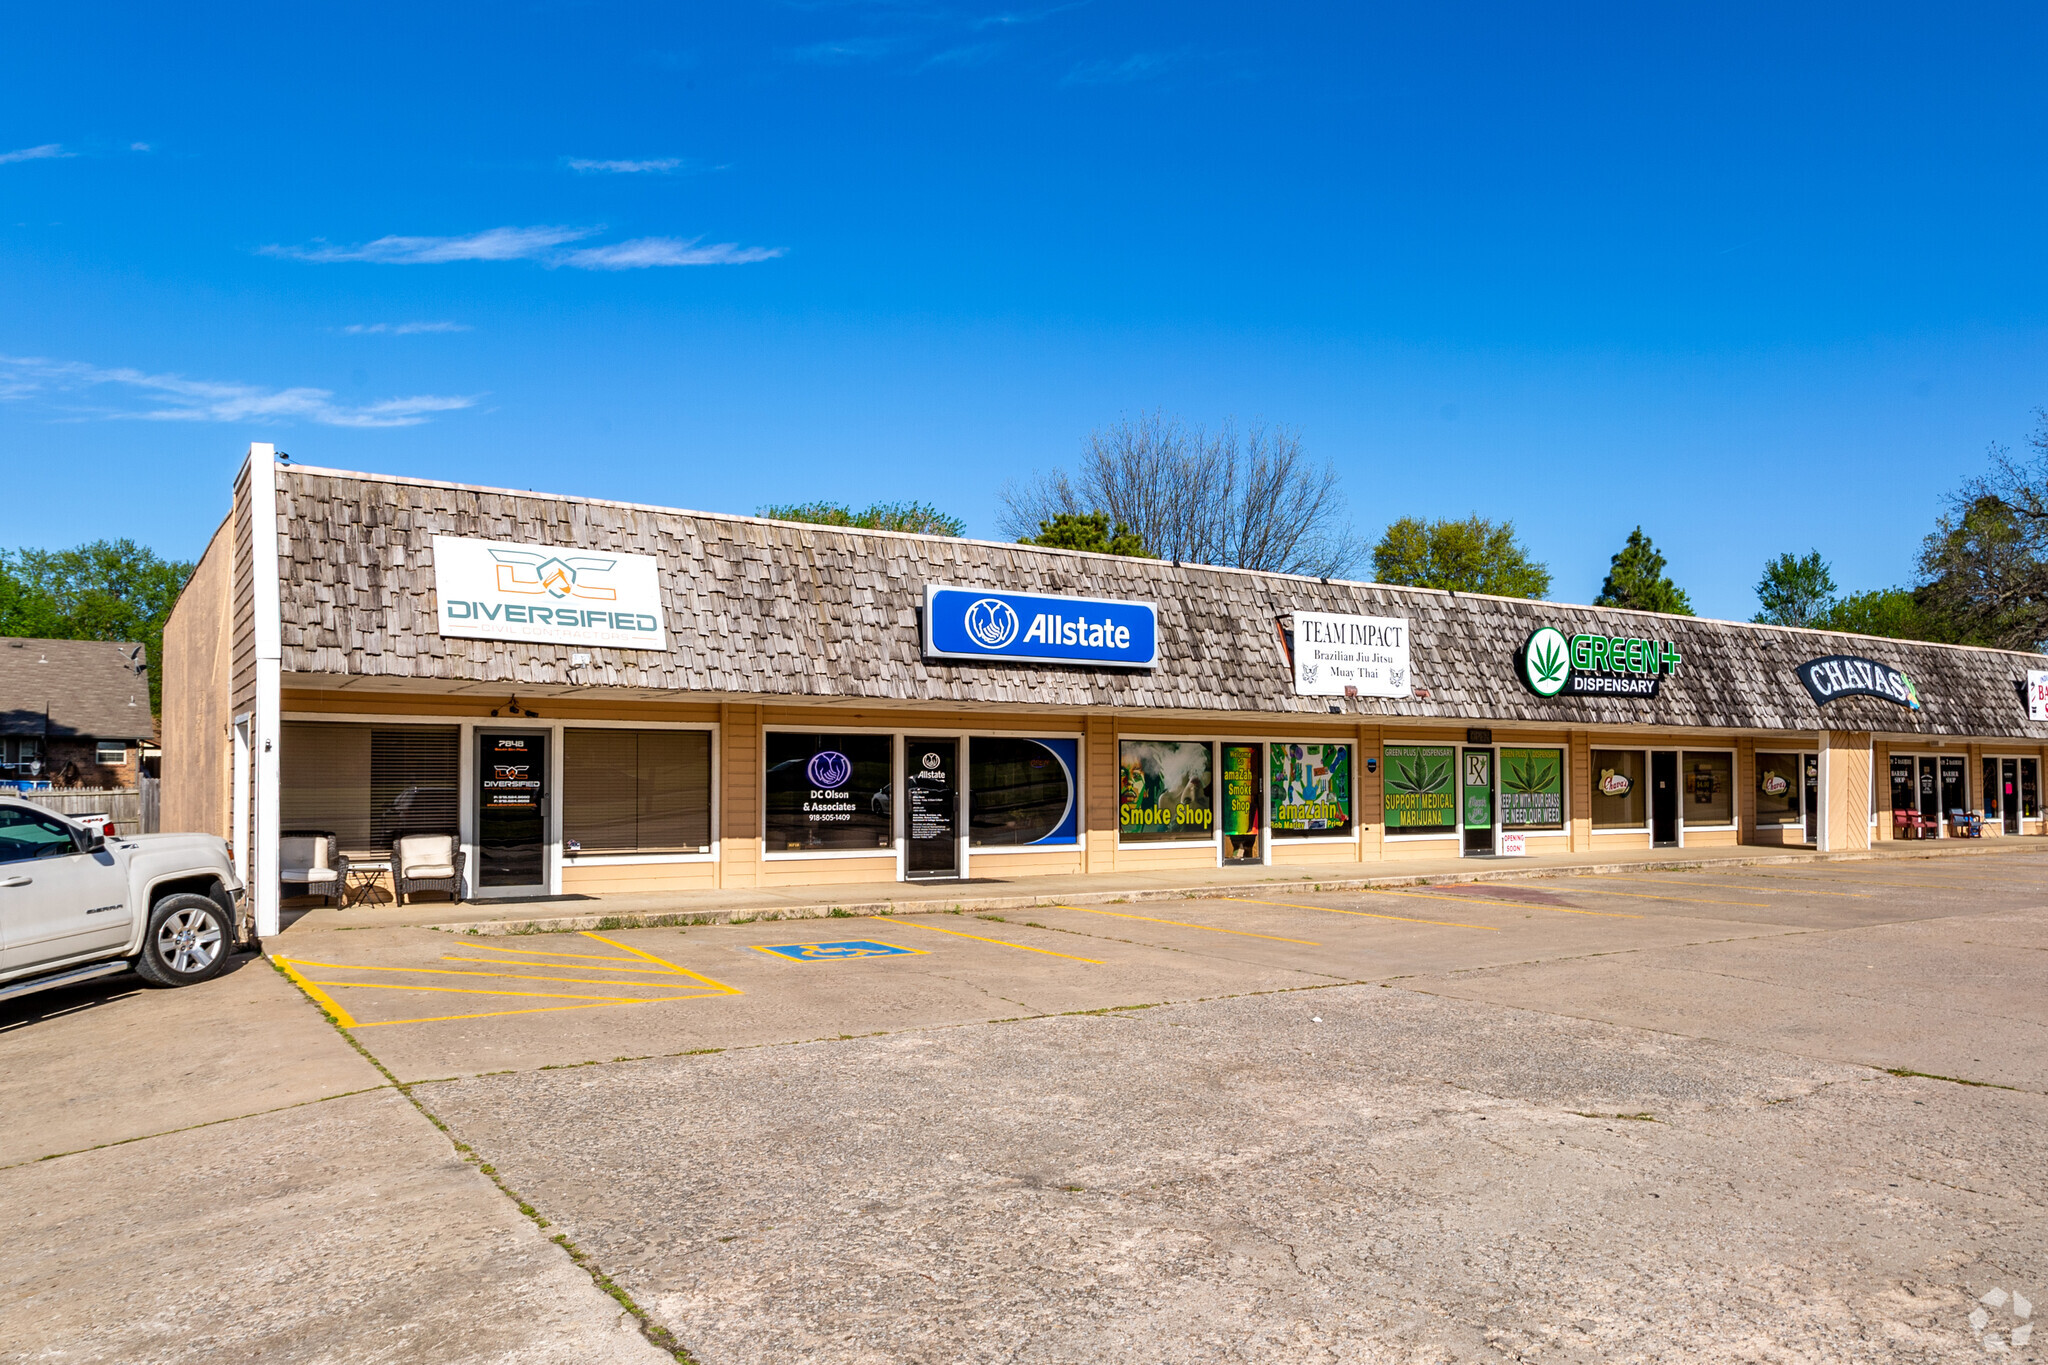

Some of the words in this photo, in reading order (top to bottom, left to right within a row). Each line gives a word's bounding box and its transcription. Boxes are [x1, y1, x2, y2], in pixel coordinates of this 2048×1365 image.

[447, 600, 657, 632] DIVERSIFIED
[481, 624, 517, 634] CIVIL
[522, 626, 629, 641] CONTRACTORS
[1023, 614, 1130, 649] Allstate
[1302, 620, 1347, 644] TEAM
[1350, 624, 1402, 647] IMPACT
[1314, 649, 1354, 662] Brazilian
[1355, 652, 1370, 663] Jiu
[1371, 653, 1393, 664] Jitsu
[1571, 634, 1681, 675] GREEN+
[1330, 666, 1355, 680] Muay
[1357, 667, 1378, 679] Thai
[1810, 660, 1906, 701] CHAVAS
[1574, 677, 1655, 693] DISPENSARY
[1385, 748, 1402, 757] GREEN
[1403, 748, 1417, 757] PLUS
[1422, 748, 1453, 757] DISPENSARY
[917, 770, 945, 779] Allstate
[1224, 768, 1252, 780] amaZah
[810, 790, 824, 799] DC
[824, 790, 849, 799] Olson
[1385, 794, 1419, 809] SUPPORT
[1422, 793, 1454, 809] MEDICAL
[1519, 793, 1532, 808] WITH
[1532, 793, 1544, 808] YOUR
[1545, 793, 1560, 808] GRASS
[803, 803, 810, 811] &
[811, 802, 856, 811] Associates
[1231, 799, 1250, 814] Shop
[1278, 800, 1337, 820] amaZahn
[808, 814, 850, 822] 918-505-1409
[1120, 803, 1171, 825] Smoke
[1176, 803, 1212, 829] Shop
[1400, 810, 1443, 826] MARIJUANA
[1511, 808, 1527, 823] NEED
[1528, 808, 1541, 823] OUR
[1543, 808, 1560, 823] WEED
[1284, 821, 1305, 829] Marley
